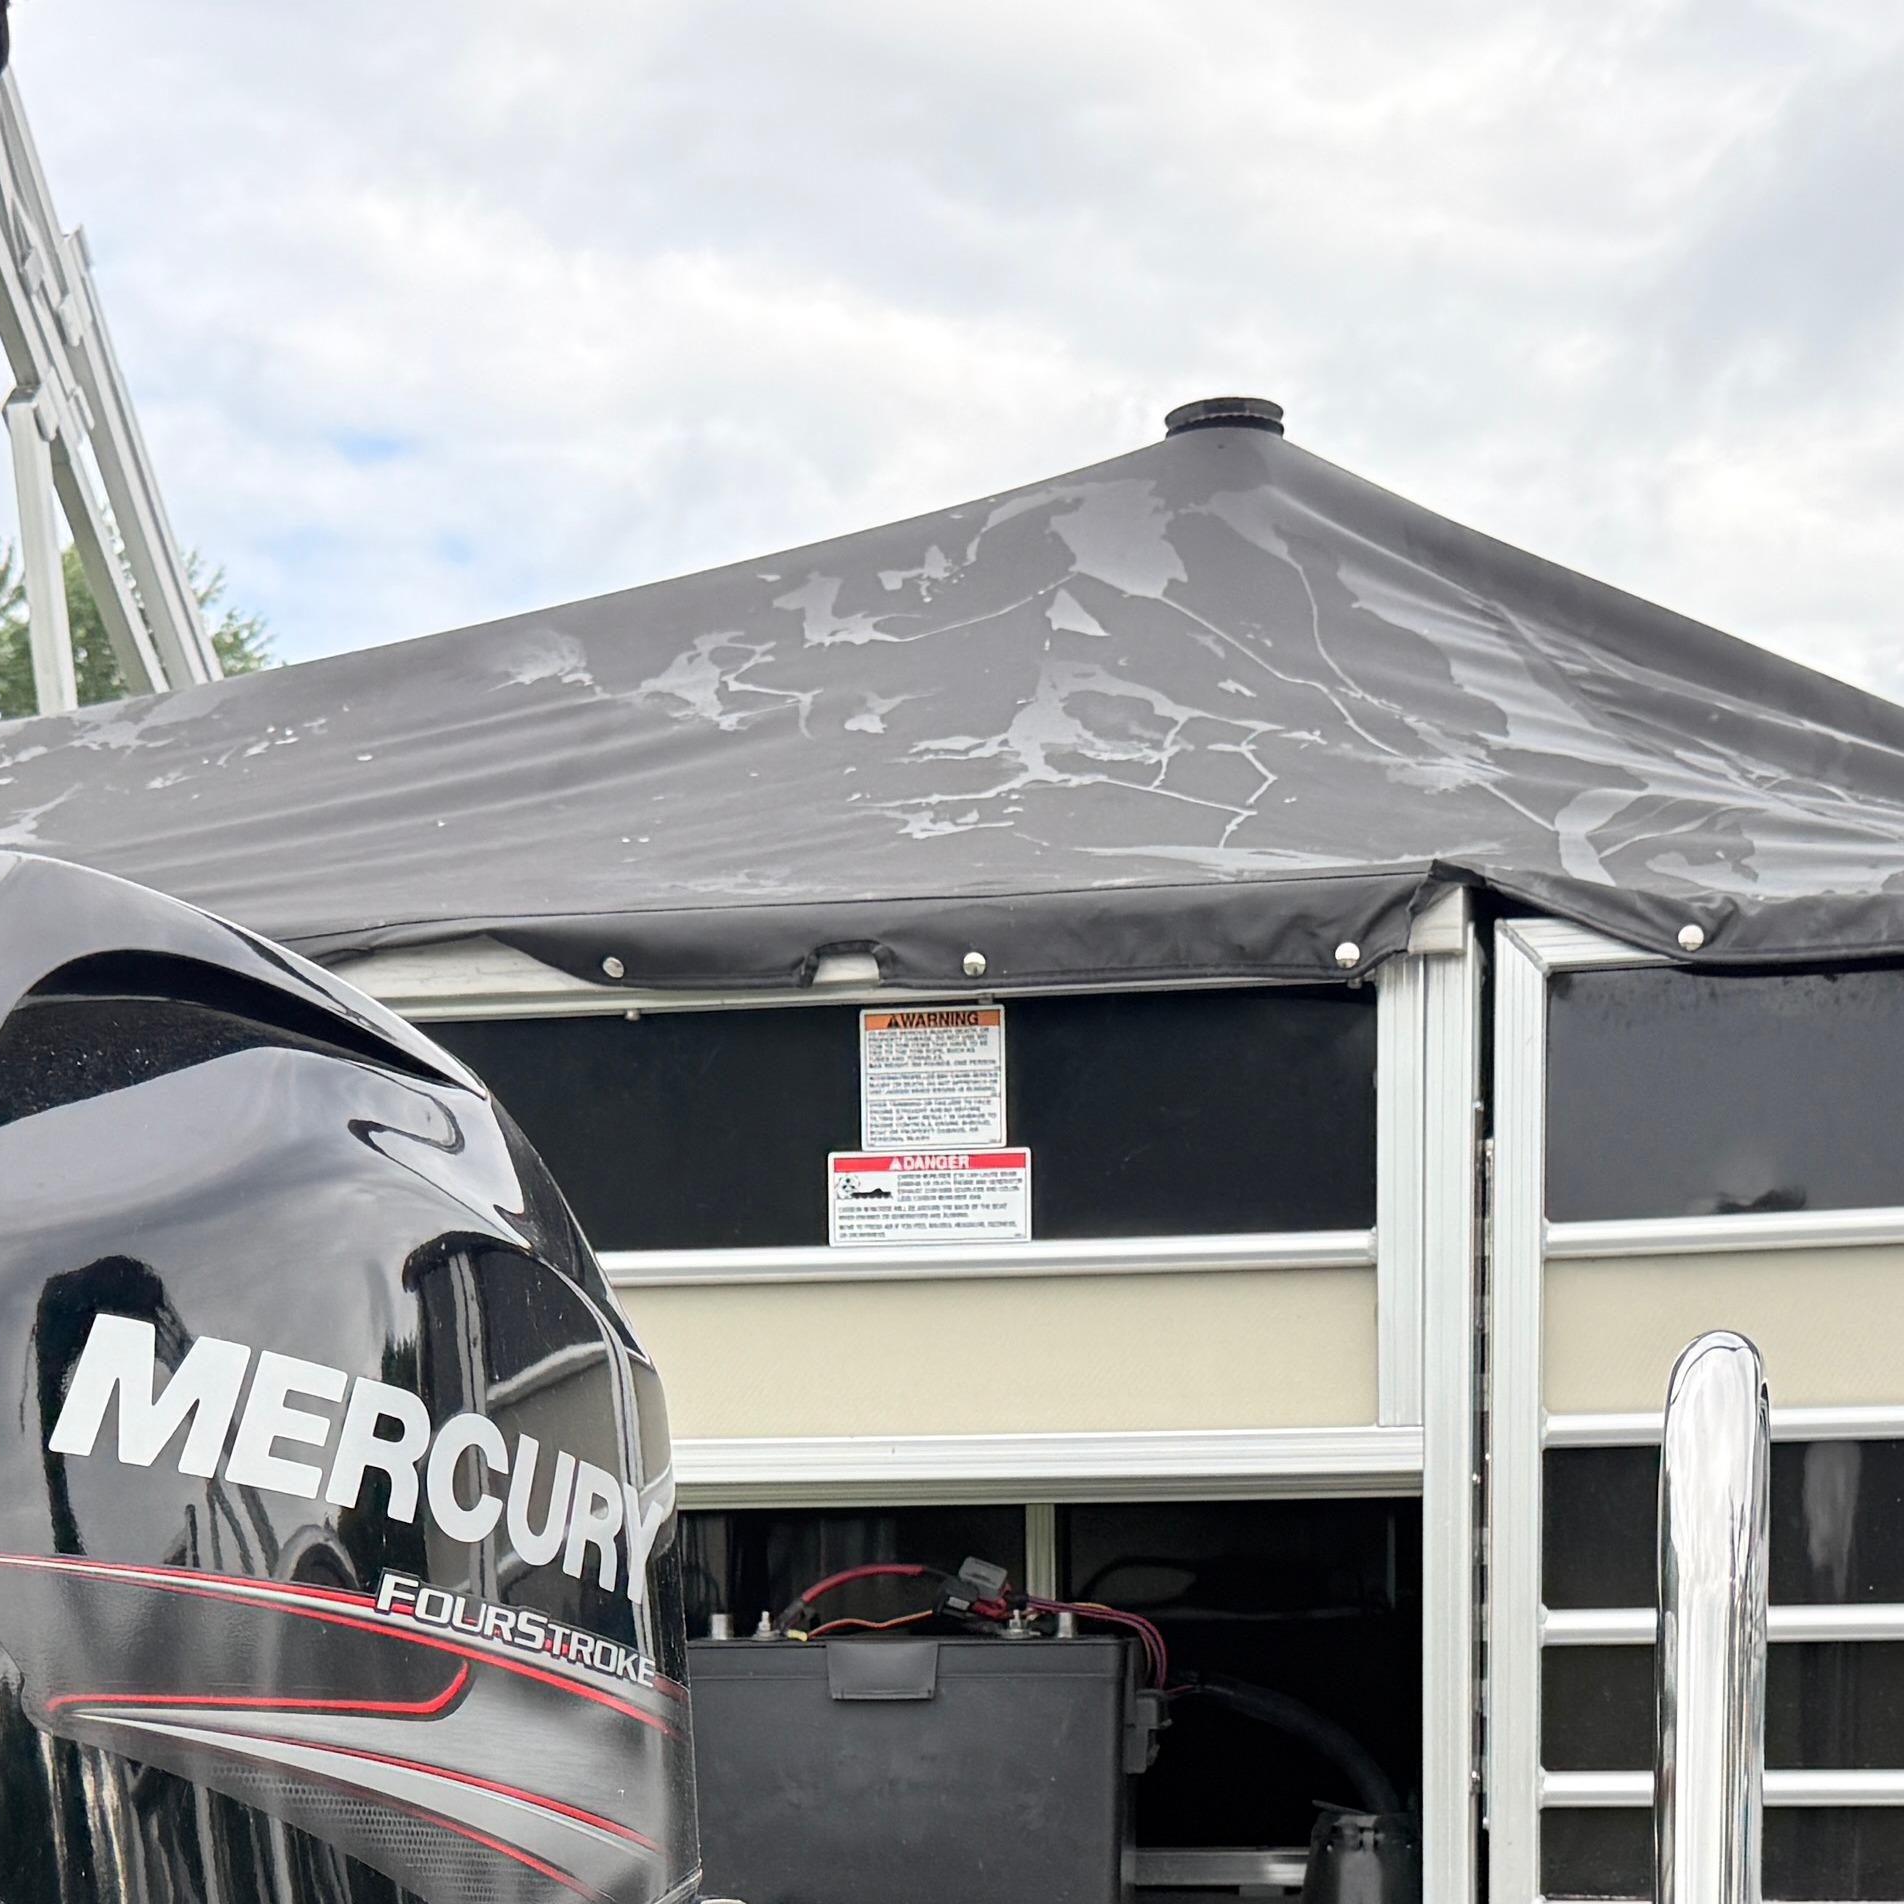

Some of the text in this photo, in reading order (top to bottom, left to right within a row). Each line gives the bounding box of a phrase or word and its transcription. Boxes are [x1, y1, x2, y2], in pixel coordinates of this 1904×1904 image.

[901, 1010, 979, 1028] WARNING
[903, 1155, 971, 1171] DANGER
[48, 1311, 664, 1605] MERCURY
